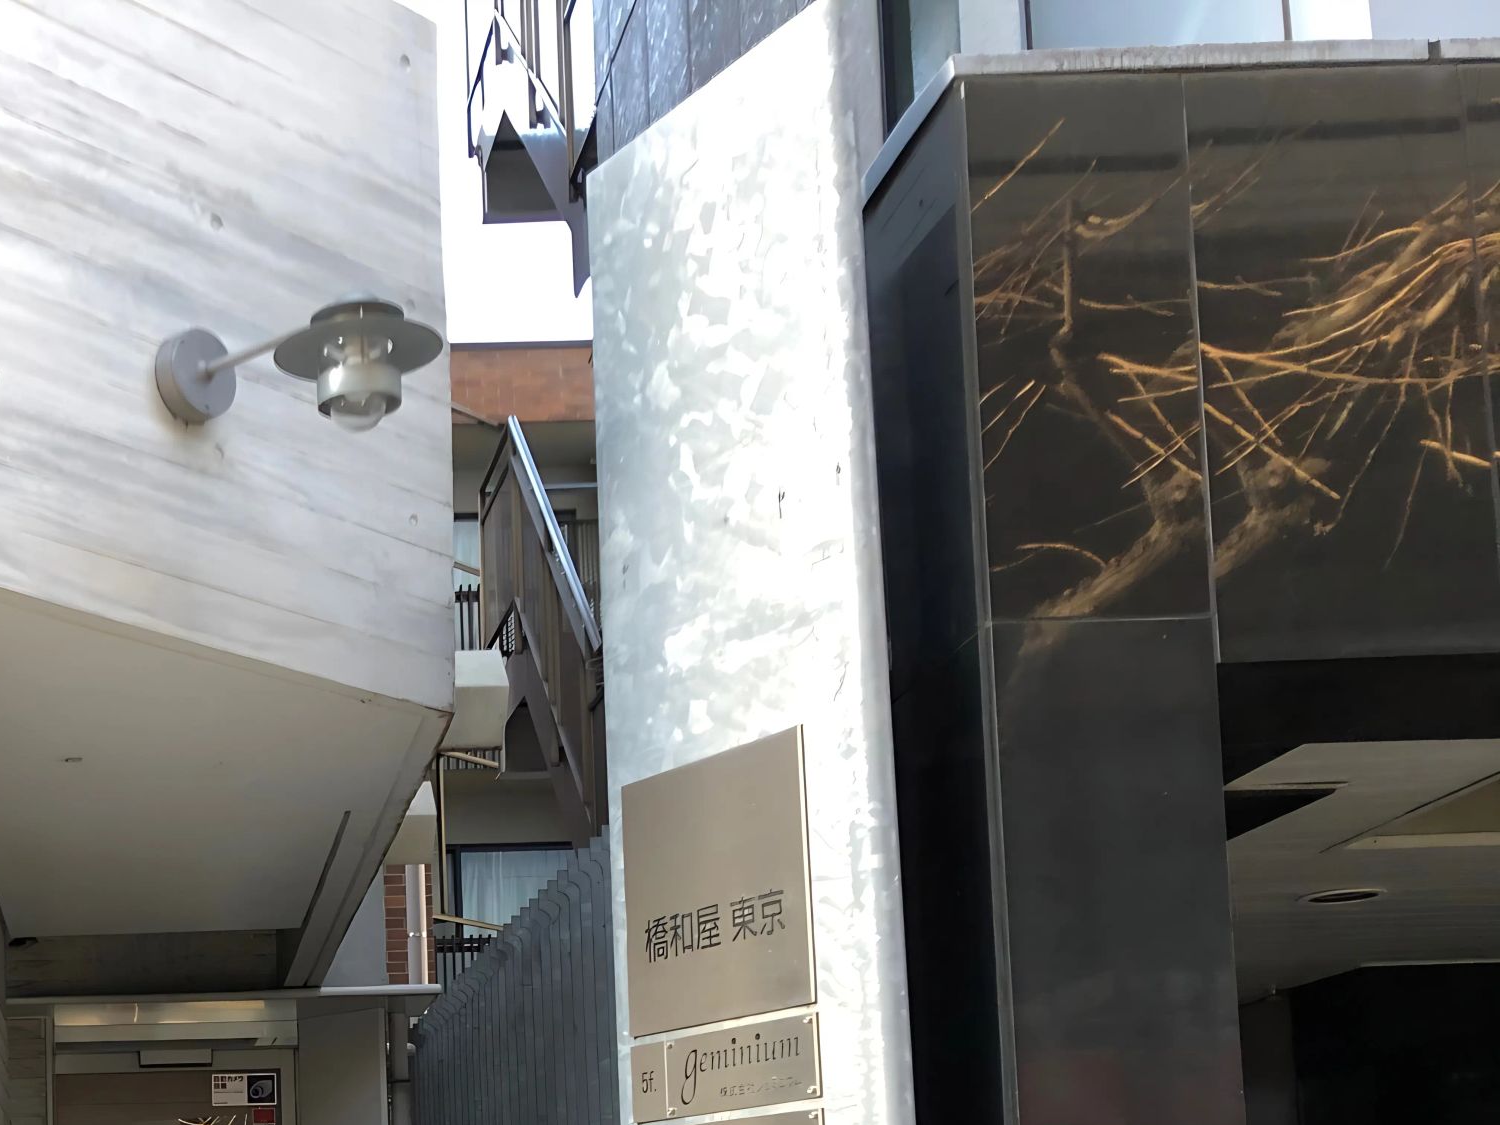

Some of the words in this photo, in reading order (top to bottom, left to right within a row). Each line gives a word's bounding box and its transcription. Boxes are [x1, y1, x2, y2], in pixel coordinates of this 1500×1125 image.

[644, 903, 722, 963] 橋和屋
[729, 888, 787, 942] 東京
[681, 1033, 801, 1106] geminium
